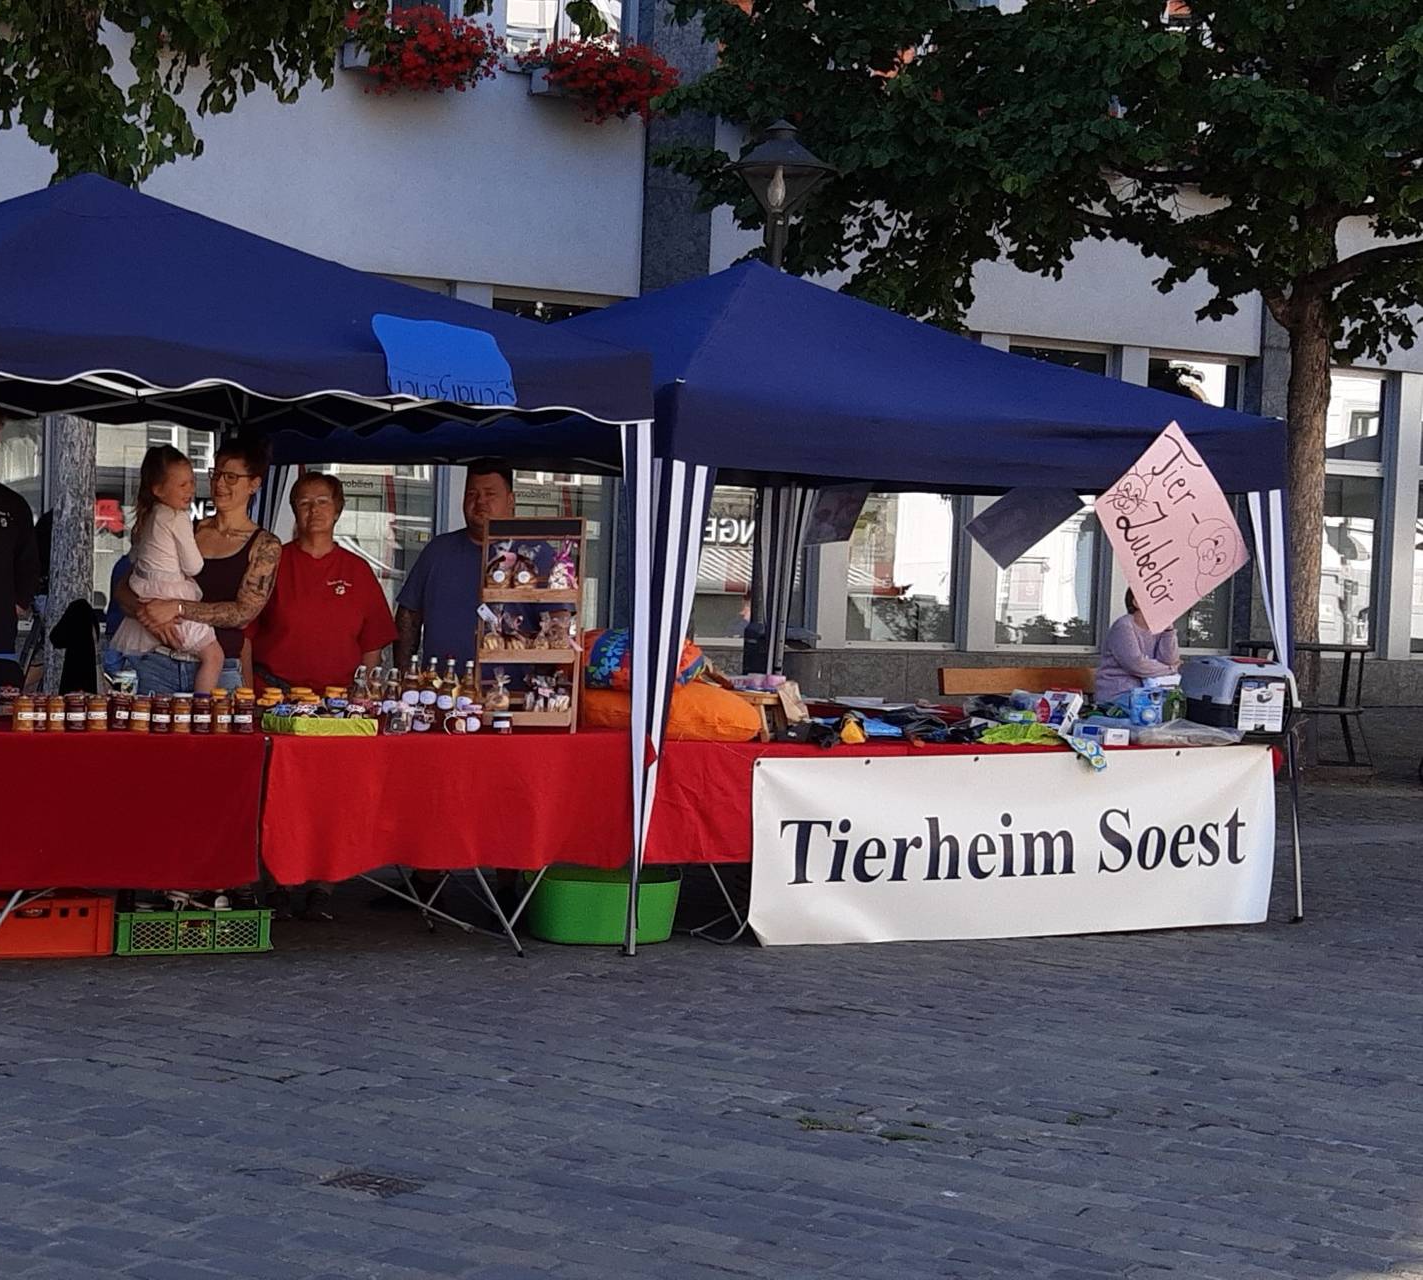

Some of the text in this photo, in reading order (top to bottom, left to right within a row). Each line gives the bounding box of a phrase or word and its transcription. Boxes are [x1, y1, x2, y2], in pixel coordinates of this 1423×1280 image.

[1115, 500, 1180, 605] Zubehör
[779, 807, 1247, 886] Tierheim Soest
